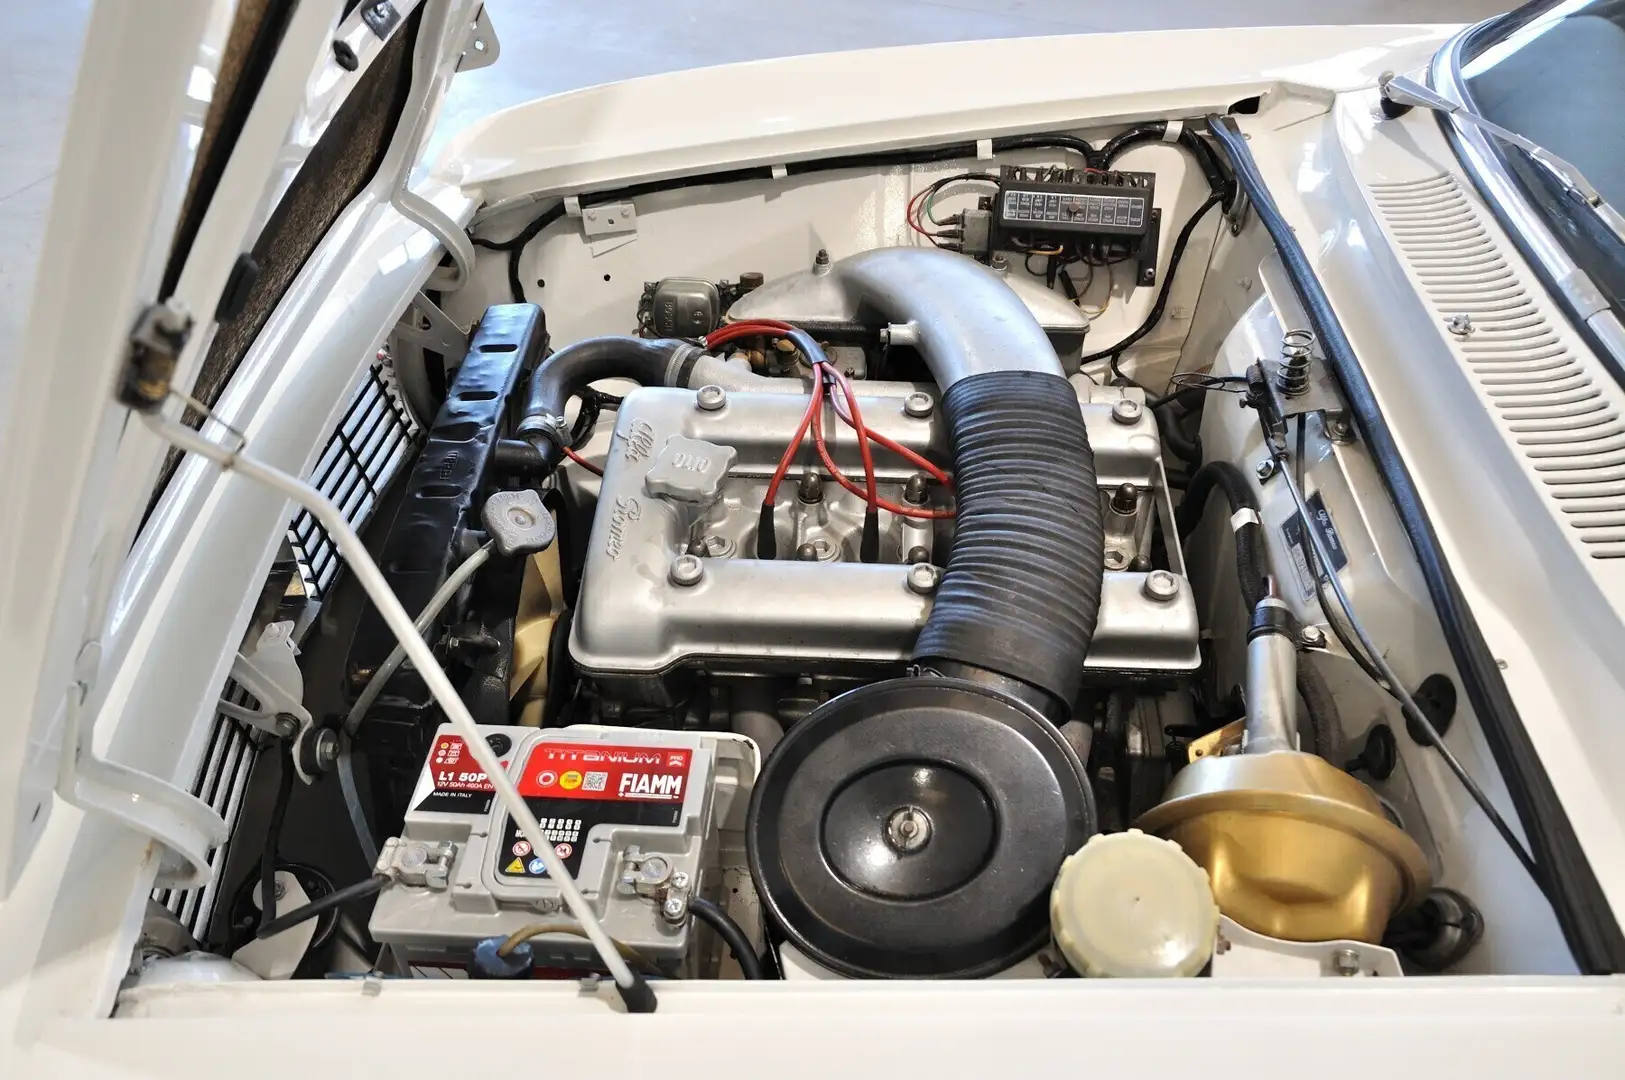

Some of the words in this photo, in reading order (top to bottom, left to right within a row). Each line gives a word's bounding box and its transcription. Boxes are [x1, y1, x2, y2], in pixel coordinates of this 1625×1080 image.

[616, 417, 656, 462] Alfa
[606, 494, 642, 561] Romeo
[1316, 509, 1328, 527] Alfa
[1325, 527, 1338, 549] Romeo
[544, 748, 662, 764] TITANIUM
[438, 771, 454, 781] L1
[458, 772, 488, 783] 50P
[619, 772, 683, 795] FIAMM
